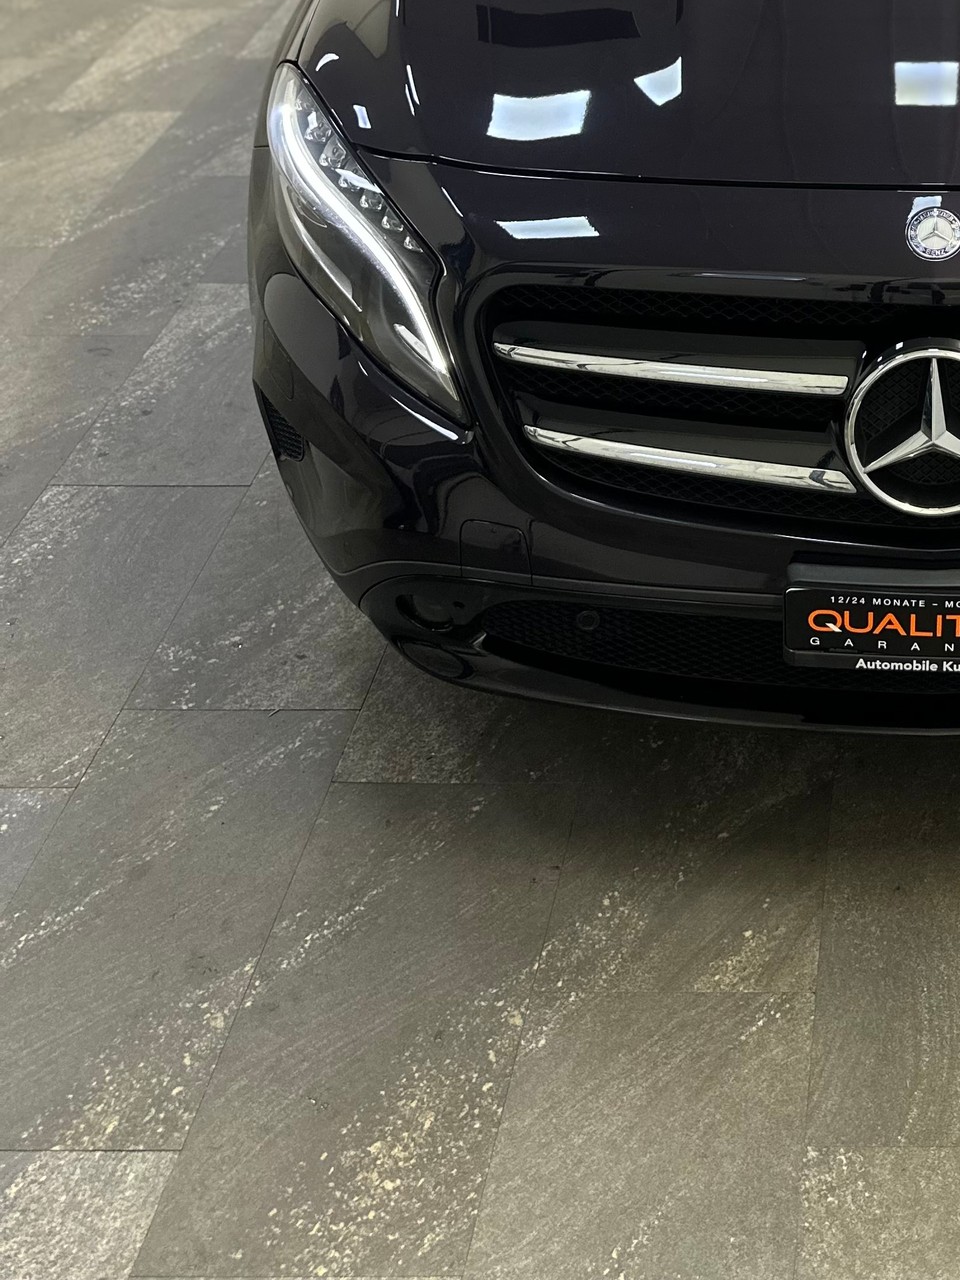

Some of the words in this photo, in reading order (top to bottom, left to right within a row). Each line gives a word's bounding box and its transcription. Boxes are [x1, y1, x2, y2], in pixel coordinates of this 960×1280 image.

[830, 596, 866, 605] 12/24
[872, 598, 926, 608] MONATE
[855, 658, 939, 672] Automobile
